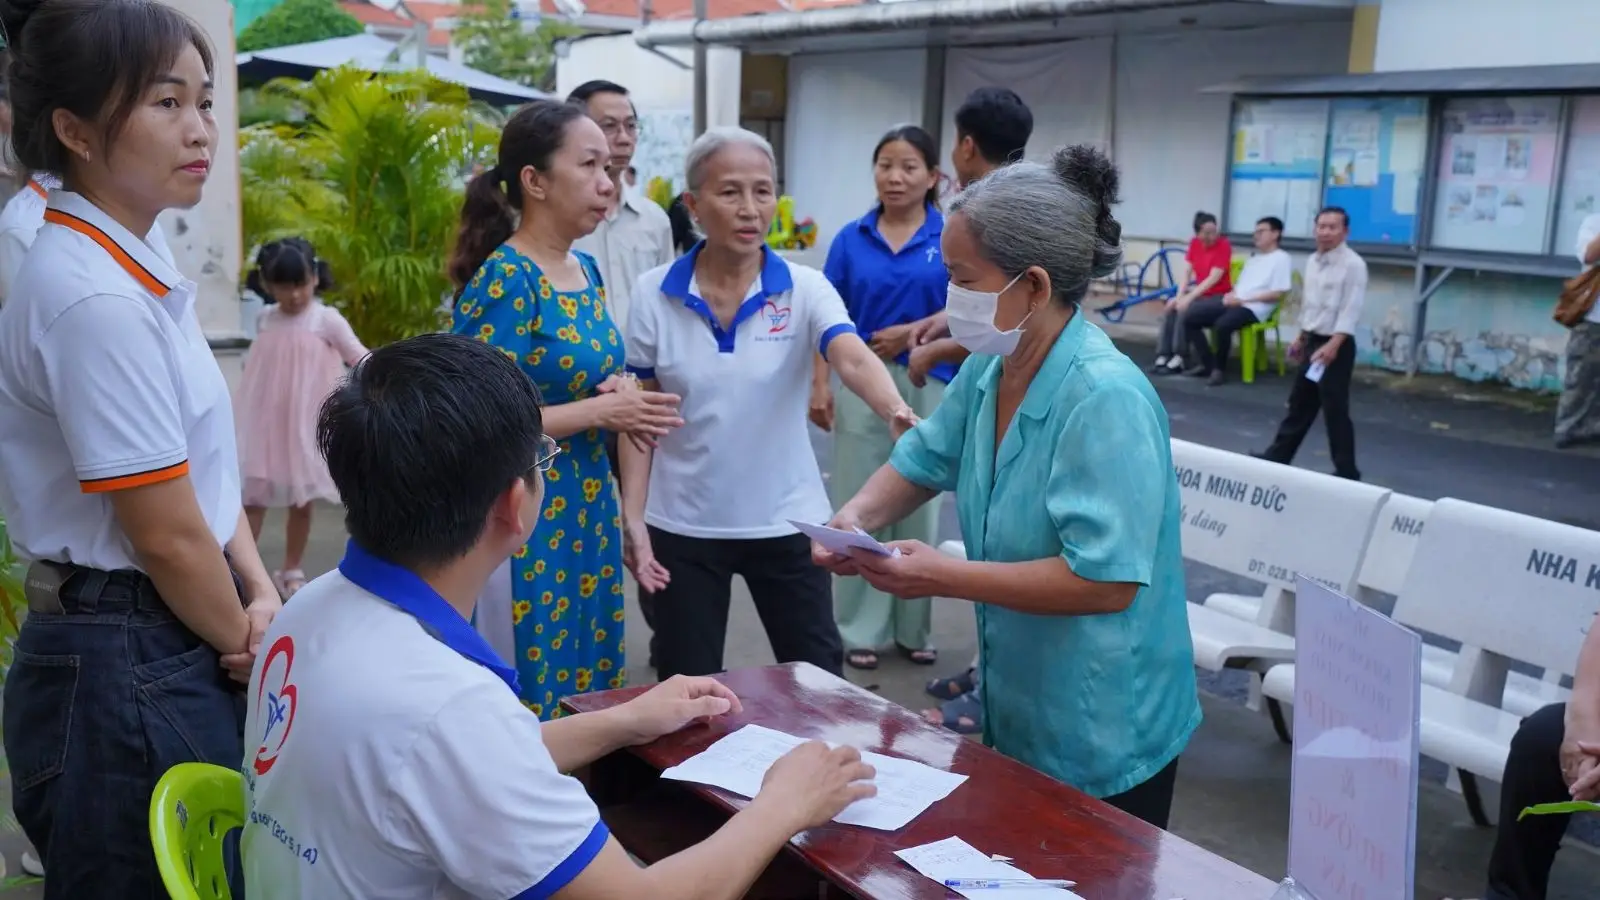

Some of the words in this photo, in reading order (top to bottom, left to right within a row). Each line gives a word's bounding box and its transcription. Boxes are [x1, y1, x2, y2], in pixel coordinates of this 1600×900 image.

[1174, 465, 1202, 491] HOA
[1205, 475, 1248, 502] MINH
[1251, 485, 1288, 512] ĐỨC
[1526, 549, 1578, 584] NHA
